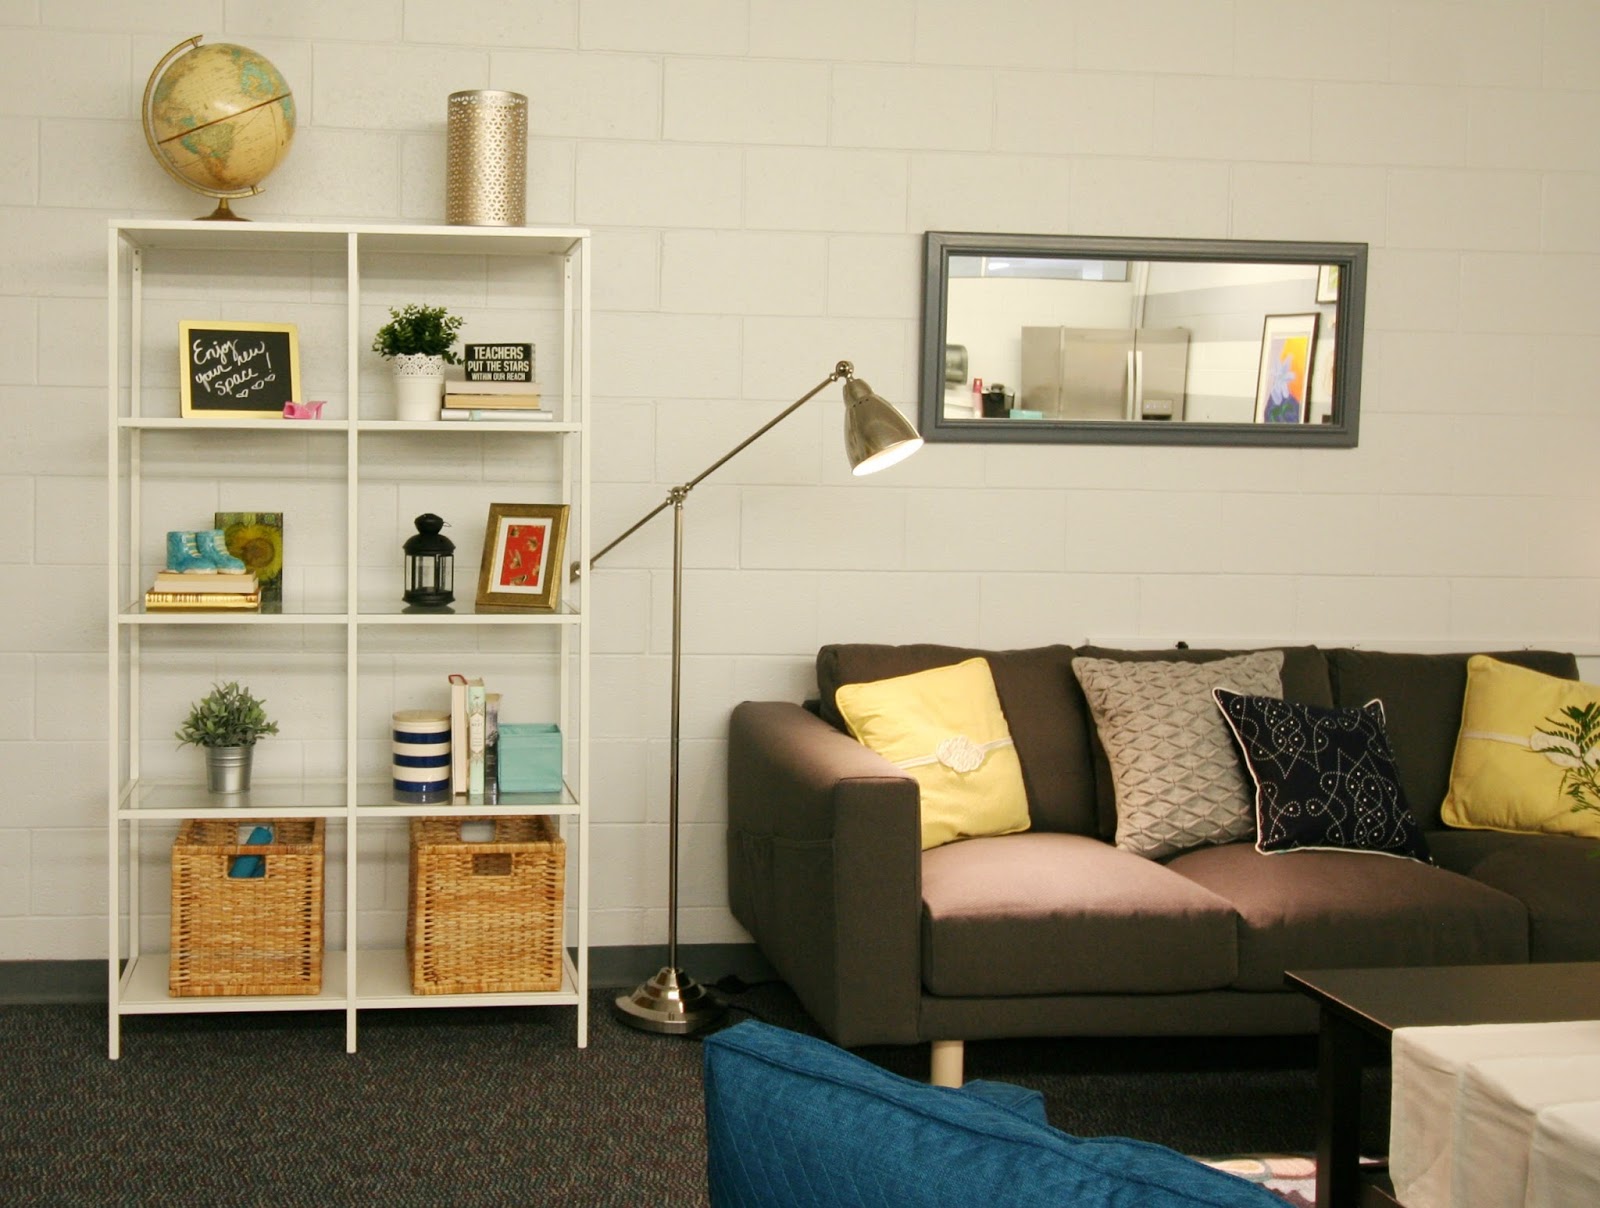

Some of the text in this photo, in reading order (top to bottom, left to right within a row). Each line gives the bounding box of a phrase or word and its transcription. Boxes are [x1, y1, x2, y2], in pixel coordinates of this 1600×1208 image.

[193, 339, 239, 365] Enjoy
[473, 346, 524, 360] TEACHERS
[195, 341, 265, 392] your new
[467, 361, 530, 372] PUT THE STARS
[471, 372, 526, 381] WITHIN OUR REACH
